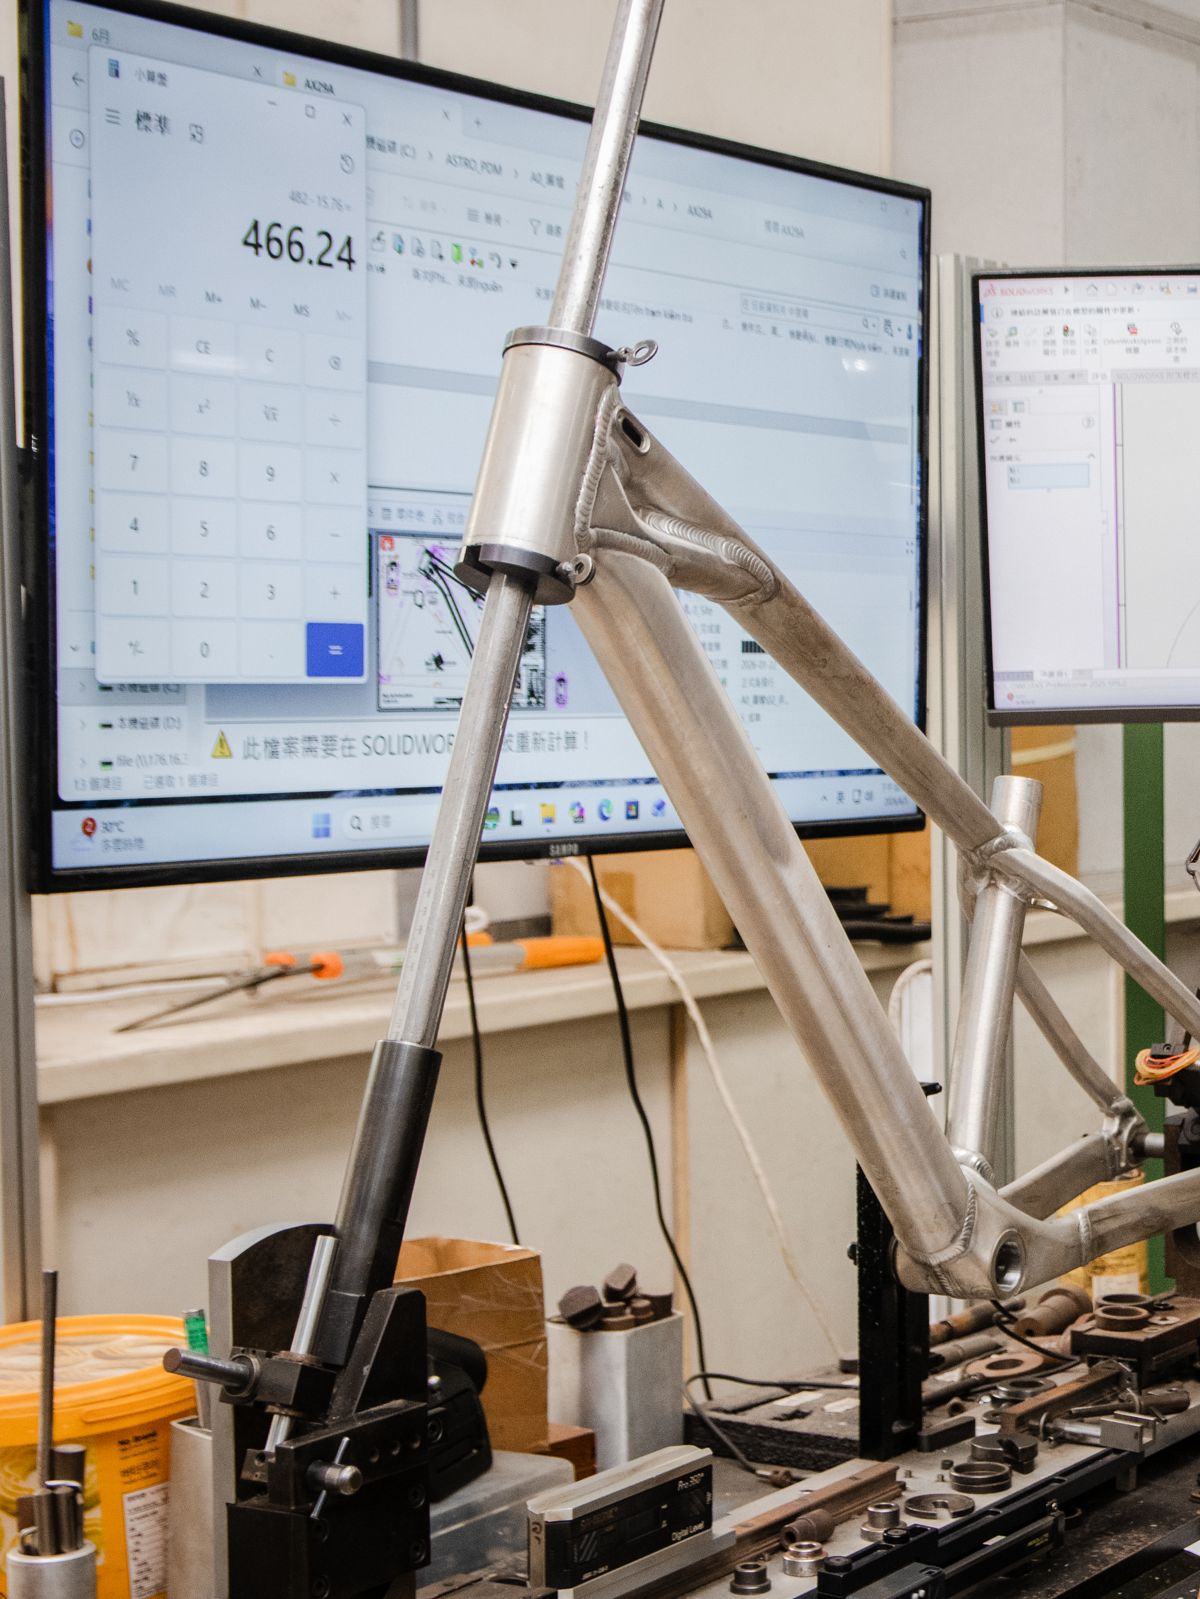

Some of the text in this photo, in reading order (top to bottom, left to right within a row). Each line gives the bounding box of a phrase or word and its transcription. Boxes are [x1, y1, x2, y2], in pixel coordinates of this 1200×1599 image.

[242, 218, 356, 271] 466.24
[111, 277, 130, 292] MC
[294, 303, 311, 317] MS
[126, 328, 141, 346] %
[195, 340, 212, 355] CE
[265, 348, 275, 363] C
[129, 454, 139, 472] 7
[199, 460, 209, 478] 8
[265, 465, 276, 482] 9
[129, 517, 139, 534] 4
[199, 520, 209, 537] 5
[266, 525, 276, 541] 6
[199, 581, 209, 599] 2
[266, 584, 276, 601] 3
[200, 641, 210, 658] 0
[243, 733, 358, 761] 此檔案需要在
[671, 1519, 705, 1541] Digital Level
